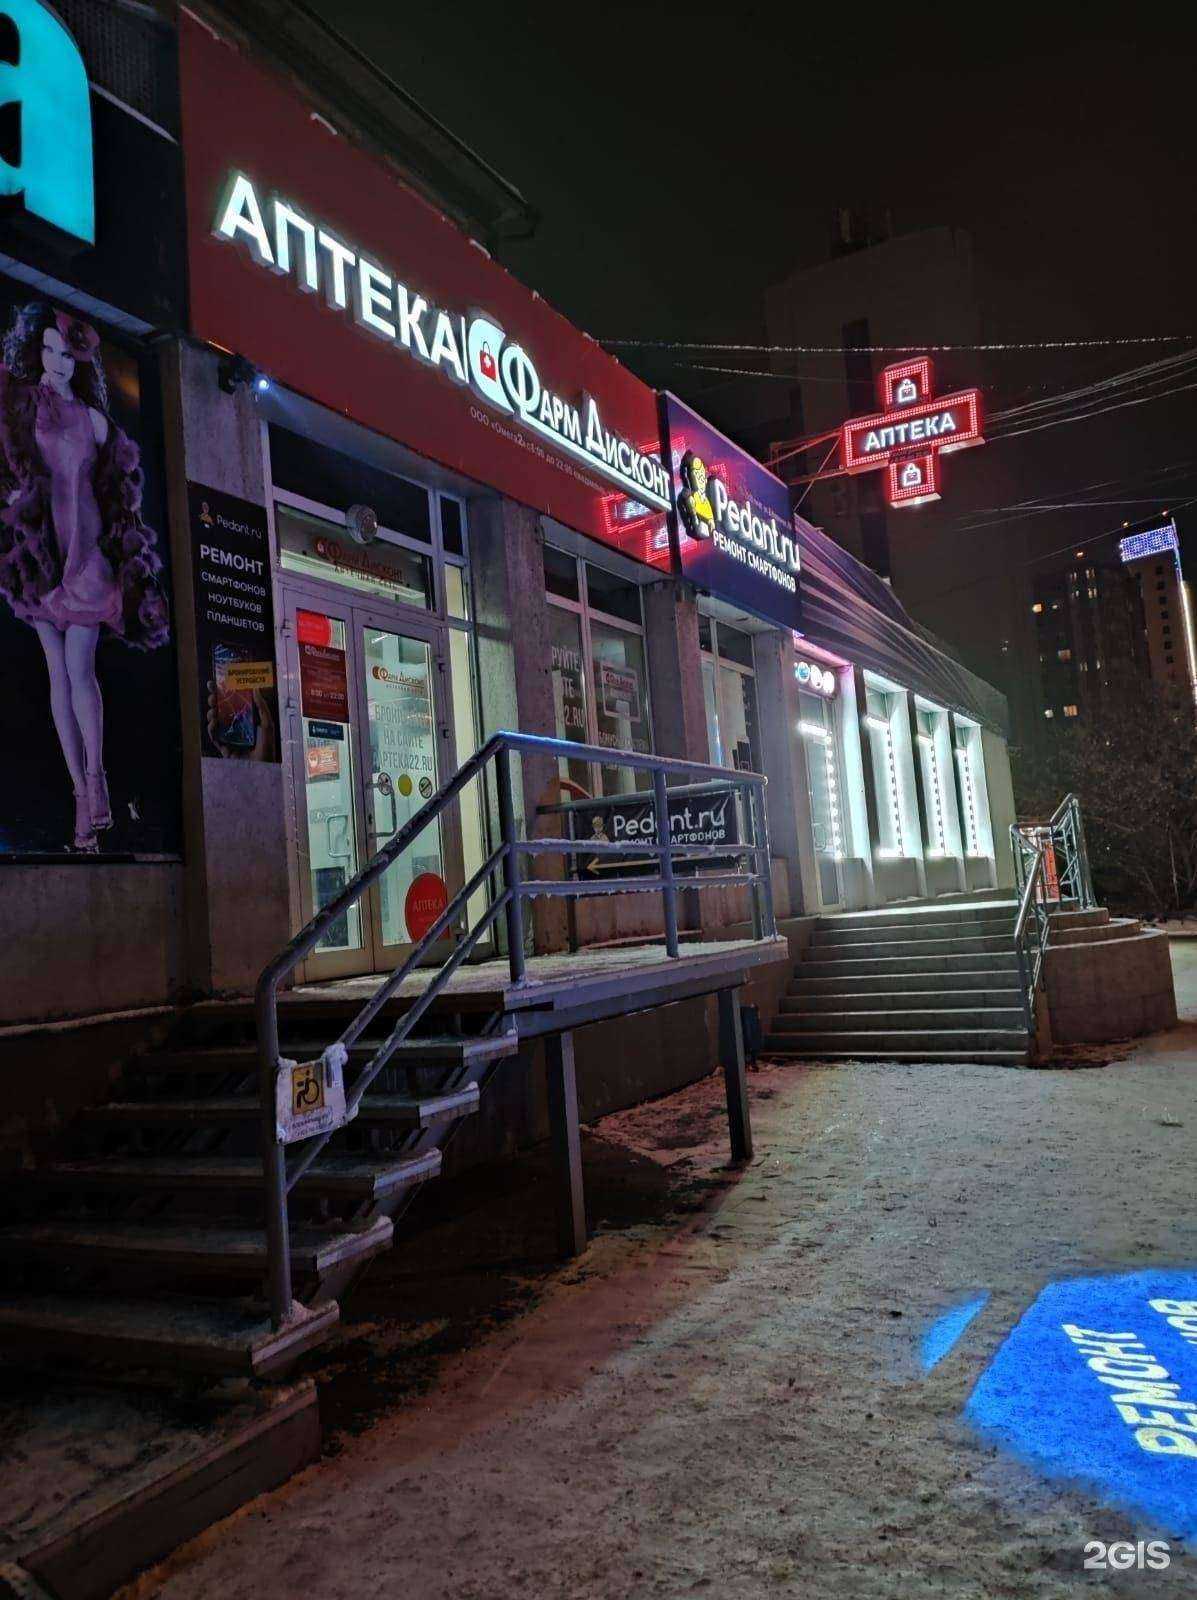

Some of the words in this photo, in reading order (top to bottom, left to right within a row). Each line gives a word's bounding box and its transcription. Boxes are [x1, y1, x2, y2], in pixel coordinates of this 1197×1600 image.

[213, 172, 467, 385] АПТЕКА
[864, 412, 956, 452] АПТЕКА
[585, 398, 671, 500] ДИСКОНТ
[200, 544, 264, 576] РЕМОНТ
[713, 530, 747, 565] РЕМОНТ
[747, 550, 796, 592] СМАРТФОНОВ
[201, 571, 266, 597] СМАРТФОНОВ
[208, 591, 262, 614] НОУТБУКОВ
[206, 610, 265, 632] ПЛАНШЕТОВ
[551, 645, 581, 673] РУЙТЕ
[613, 806, 726, 838] Pednt.ru
[655, 829, 726, 846] АРТФОНОВ
[1062, 1323, 1197, 1458] РЕМОНТ
